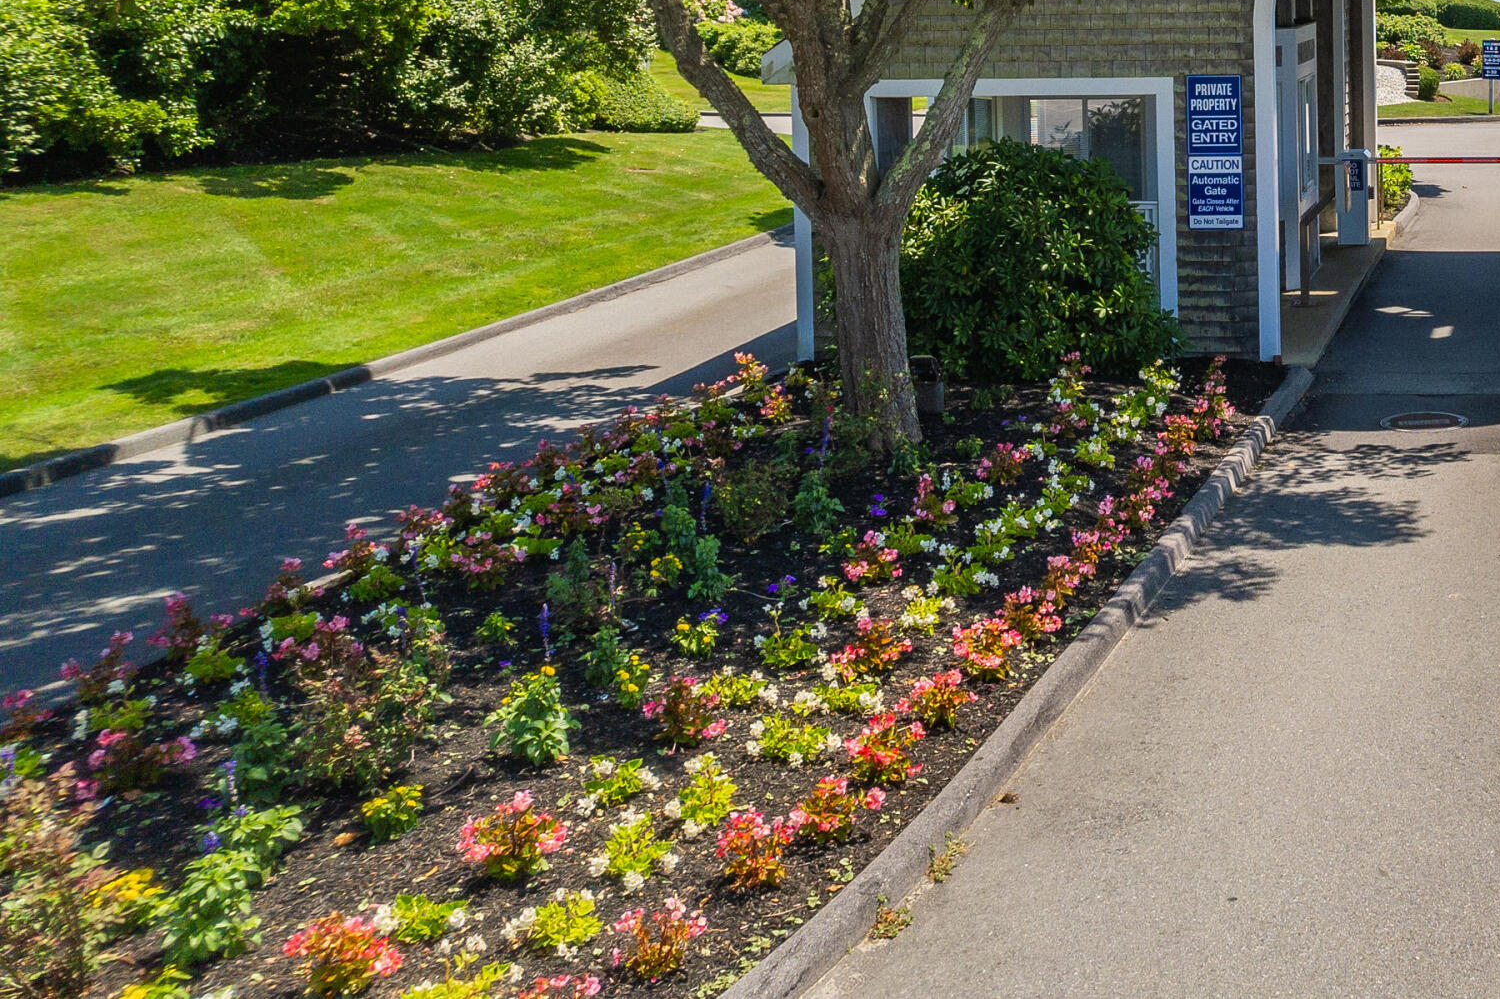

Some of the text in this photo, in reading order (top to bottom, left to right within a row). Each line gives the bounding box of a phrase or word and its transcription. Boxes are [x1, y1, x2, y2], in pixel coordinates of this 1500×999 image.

[1195, 83, 1232, 96] PRIVATE
[1190, 98, 1237, 111] PROPERTY
[1191, 120, 1238, 130] GATED
[1192, 132, 1237, 143] ENTRY
[1191, 160, 1240, 170] CAUTION
[1192, 175, 1239, 185] Automatic
[1204, 186, 1227, 195] Gate
[1216, 218, 1239, 226] Tailgate
